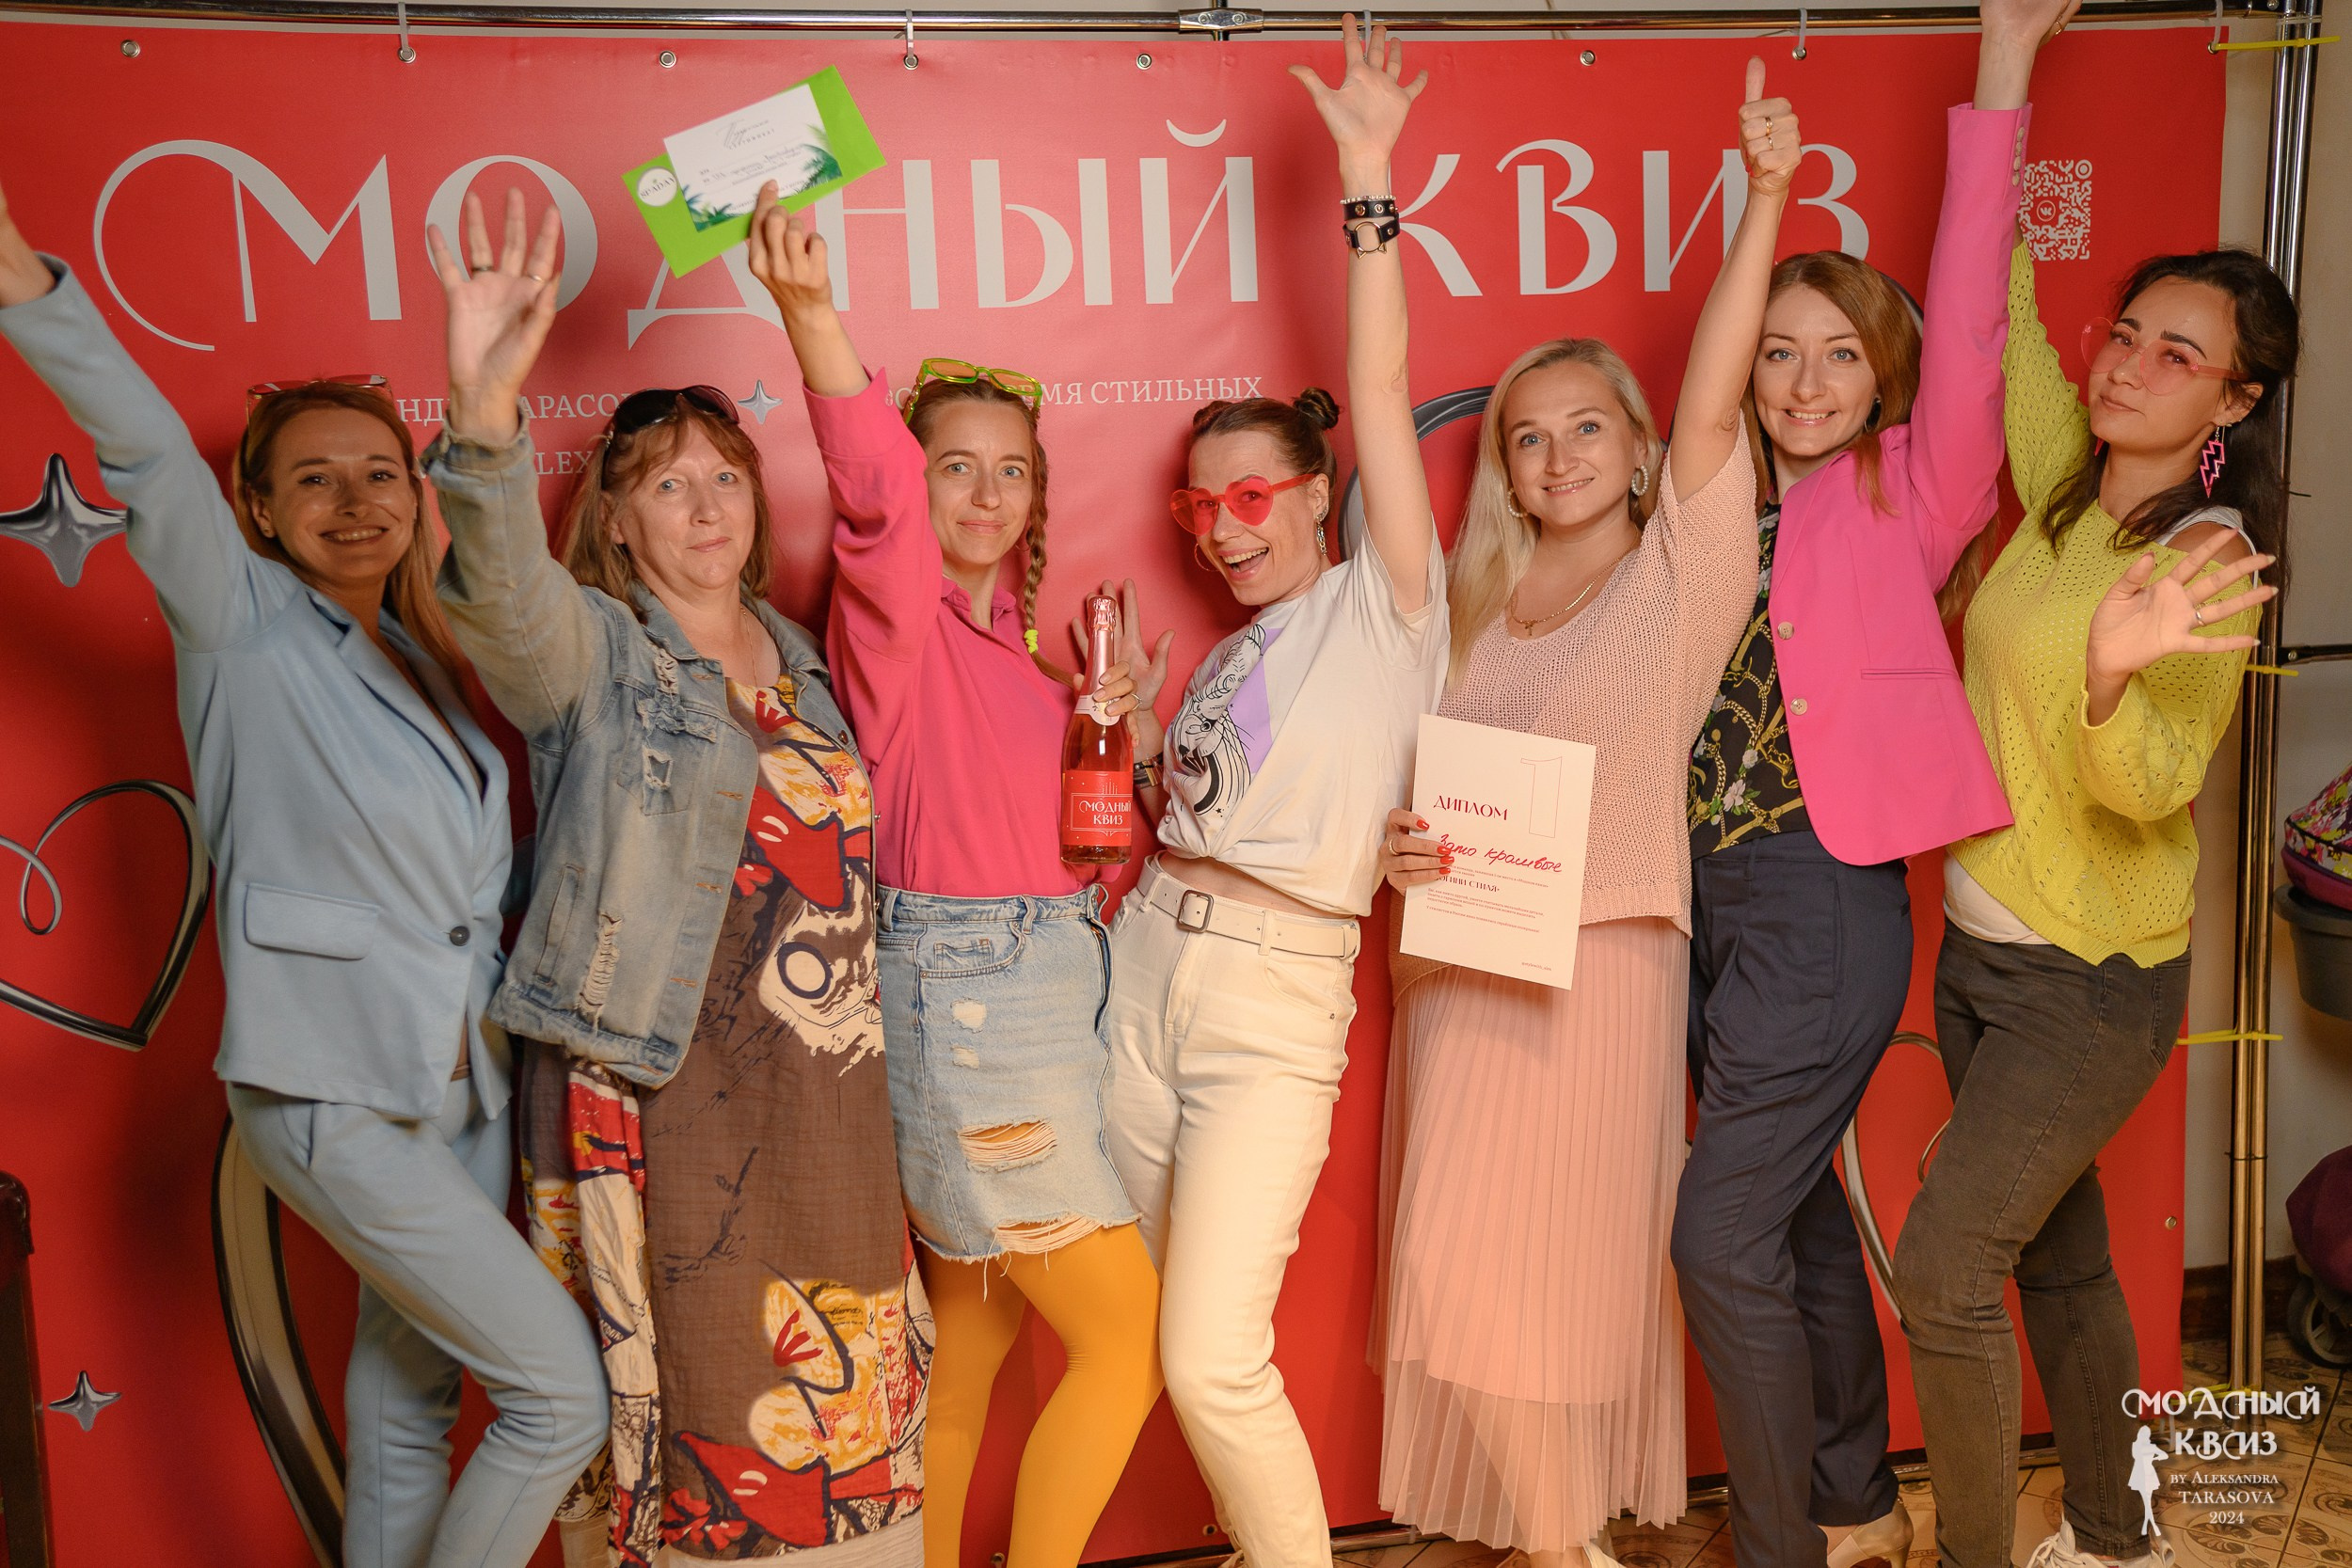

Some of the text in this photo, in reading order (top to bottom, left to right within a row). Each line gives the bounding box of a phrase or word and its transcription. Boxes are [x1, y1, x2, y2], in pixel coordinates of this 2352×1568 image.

[1090, 376, 1263, 404] СТИЛЬНЫХ
[1093, 814, 1123, 826] КВИЗ
[1433, 795, 1508, 821] ДИПЛОМ
